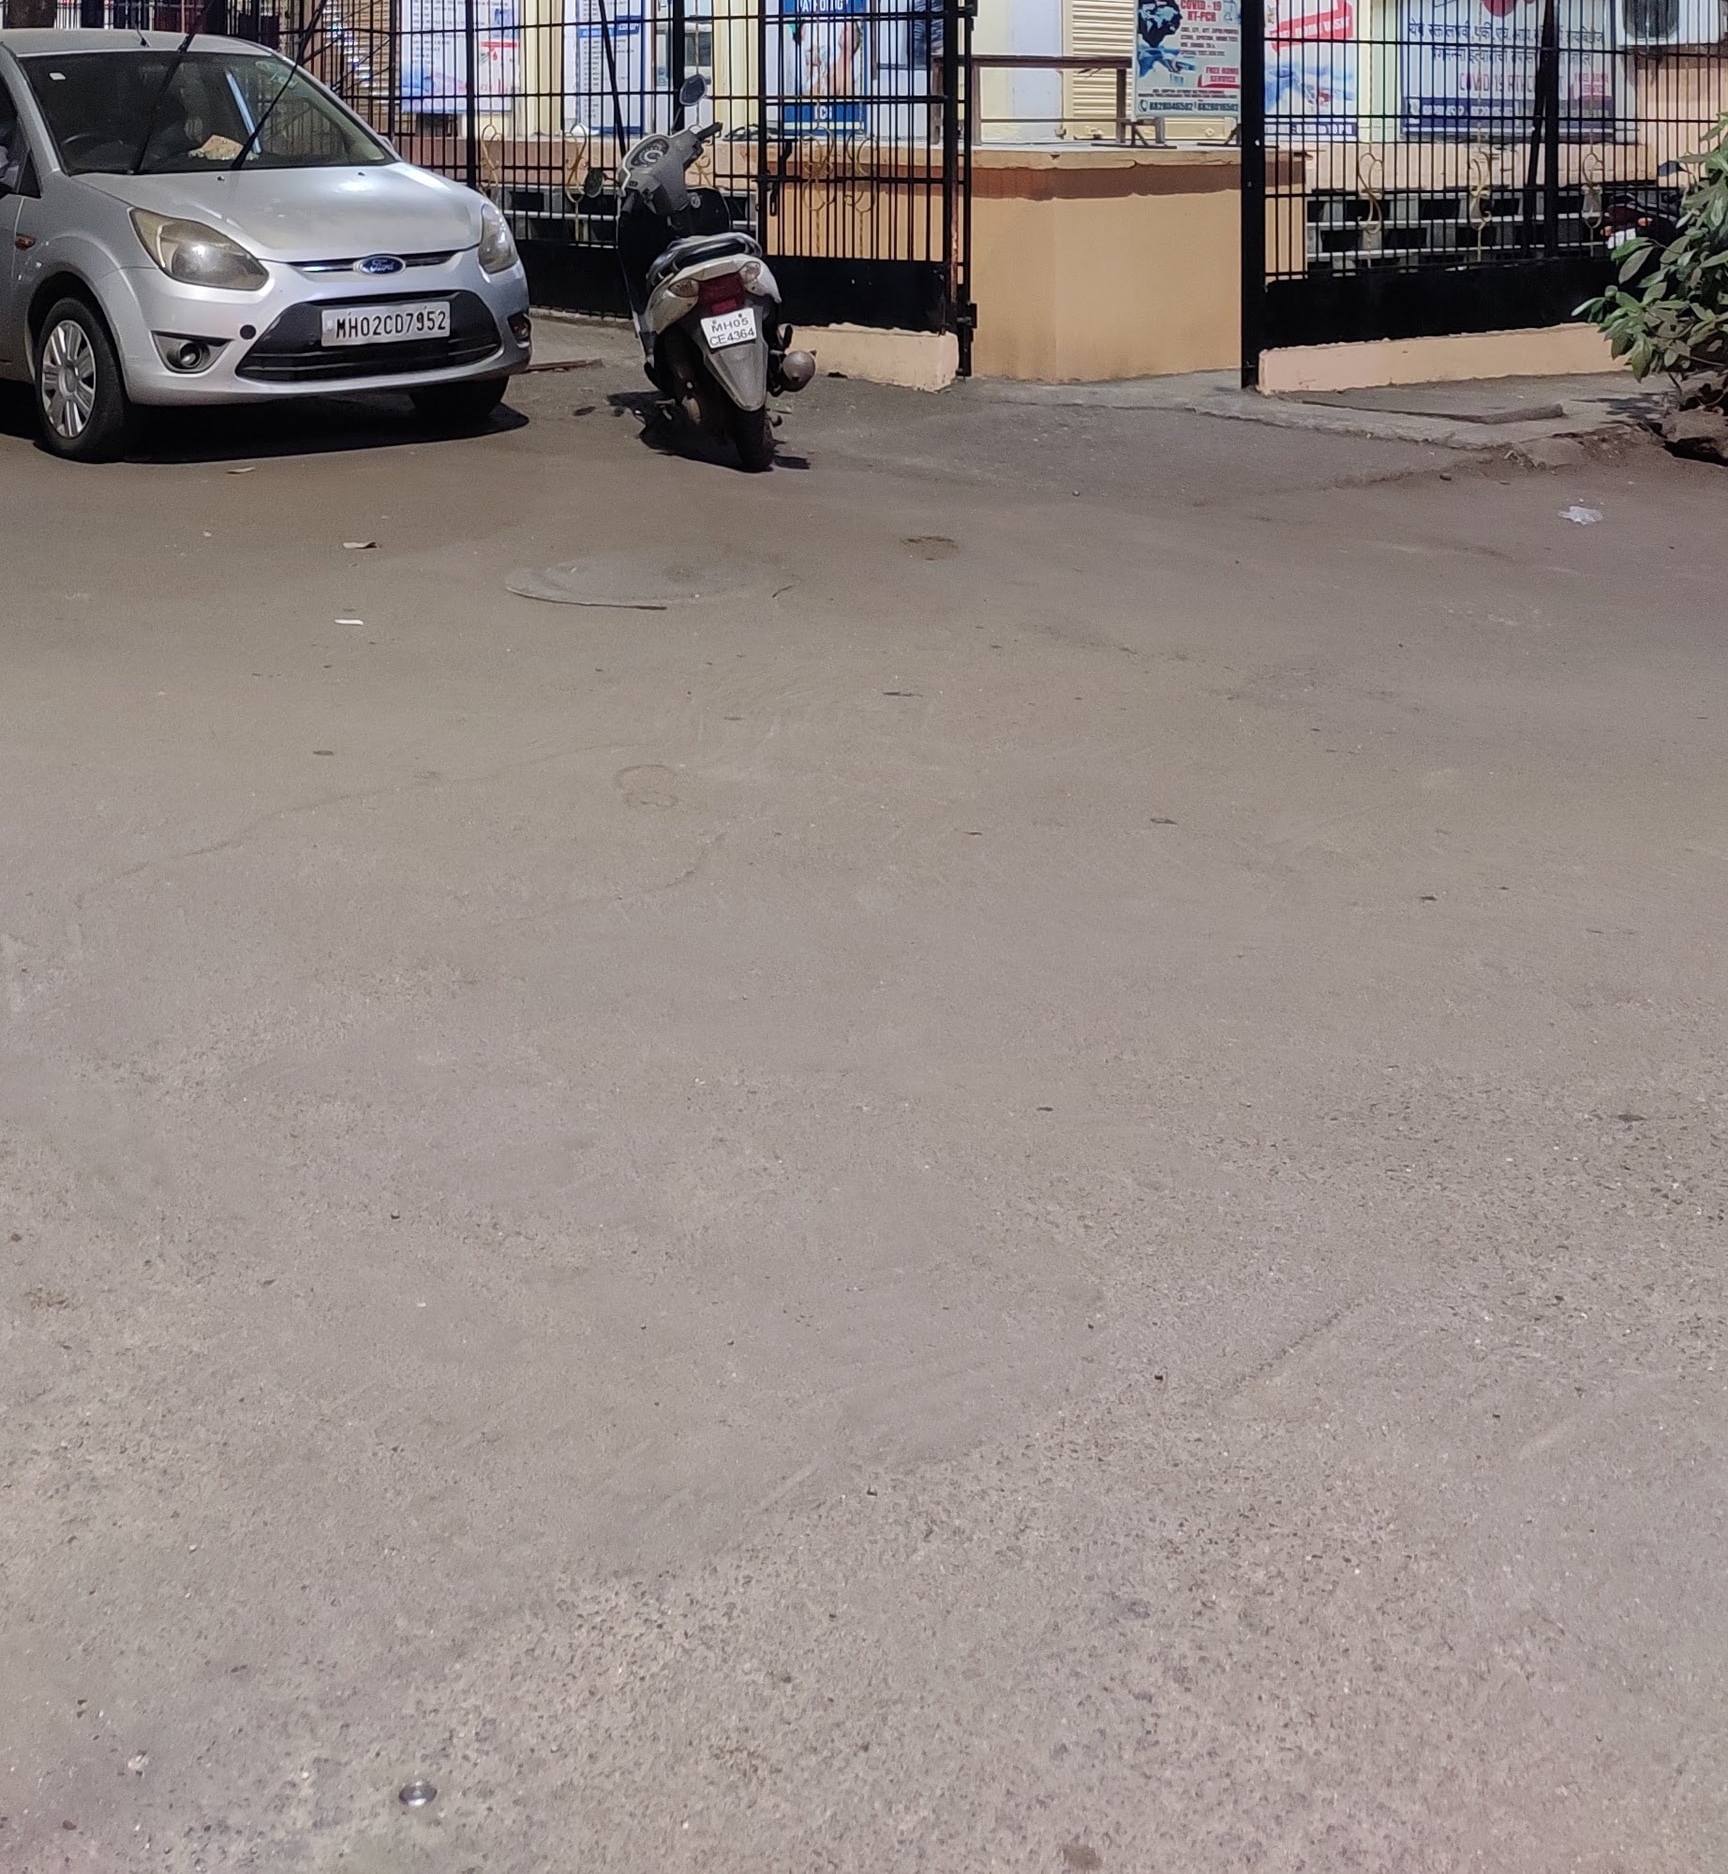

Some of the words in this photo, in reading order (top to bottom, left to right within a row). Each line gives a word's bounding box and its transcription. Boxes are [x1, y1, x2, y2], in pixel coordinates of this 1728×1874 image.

[369, 259, 394, 272] Ford
[336, 310, 446, 339] MH02CD7952
[711, 317, 749, 333] MH05
[709, 327, 755, 346] CE4364
